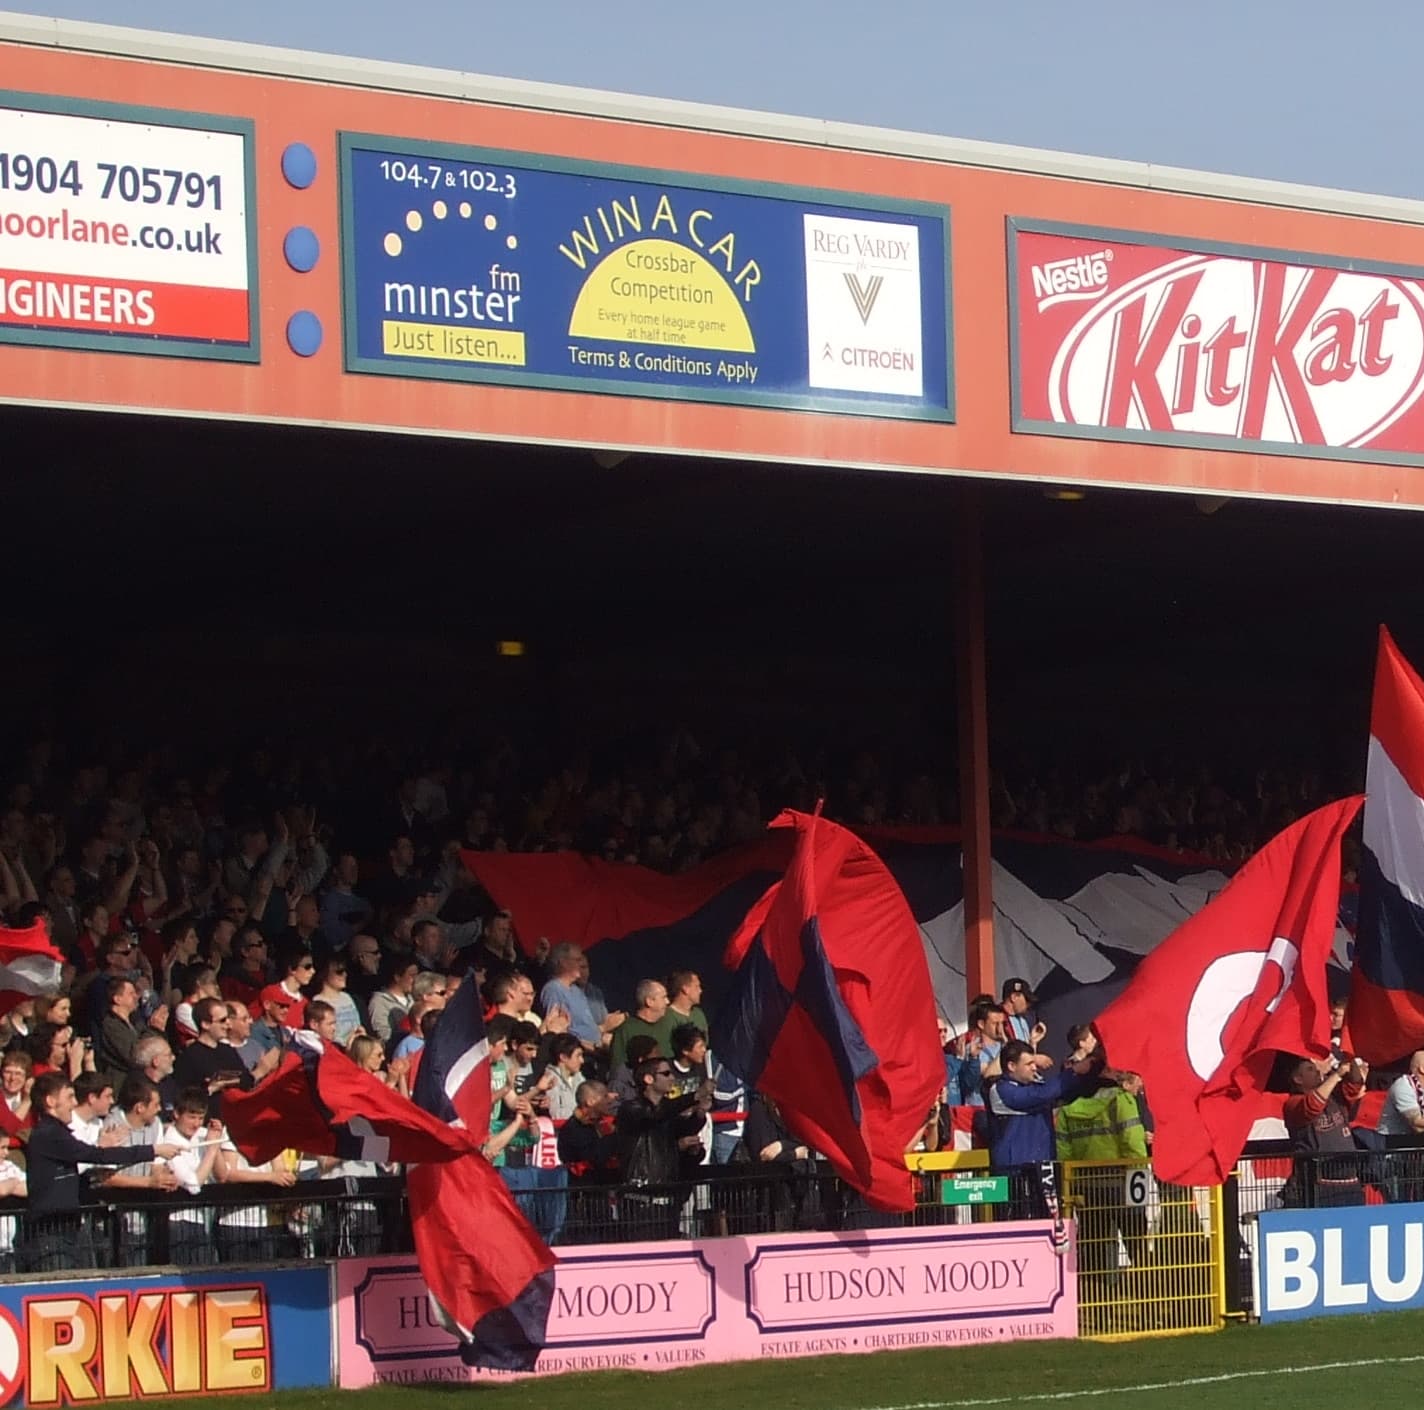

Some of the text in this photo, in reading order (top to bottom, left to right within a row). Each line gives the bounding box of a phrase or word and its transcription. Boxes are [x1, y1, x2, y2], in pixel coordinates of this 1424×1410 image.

[97, 163, 222, 210] 705791
[381, 160, 442, 189] 104.7
[459, 169, 516, 198] 102.3
[0, 209, 222, 254] oorlane.co.uk
[813, 229, 910, 261] REG VARDY
[559, 195, 761, 301] WIN A CAR
[626, 250, 695, 275] Crossbar
[490, 264, 520, 292] fm
[610, 277, 713, 305] Competition
[385, 282, 520, 323] minster
[598, 308, 726, 333] Every home league game
[626, 328, 687, 344] at half time
[393, 327, 434, 351] Just
[568, 346, 758, 384] Terms & Conditions Apply
[841, 347, 914, 372] CITROËN
[542, 1131, 556, 1169] CITY
[954, 1180, 997, 1191] Emergency
[968, 1191, 983, 1202] exit
[1129, 1170, 1146, 1205] 6
[784, 1258, 1030, 1304] HUDSON MOODY
[555, 1281, 678, 1319] MOODY
[761, 1321, 1055, 1356] ESTATE AGENTS CHARTERED SURVEYORS VALUERS
[422, 1368, 469, 1383] AGENTS
[566, 1353, 637, 1371] SURVEYORS
[655, 1349, 705, 1363] VALUERS
